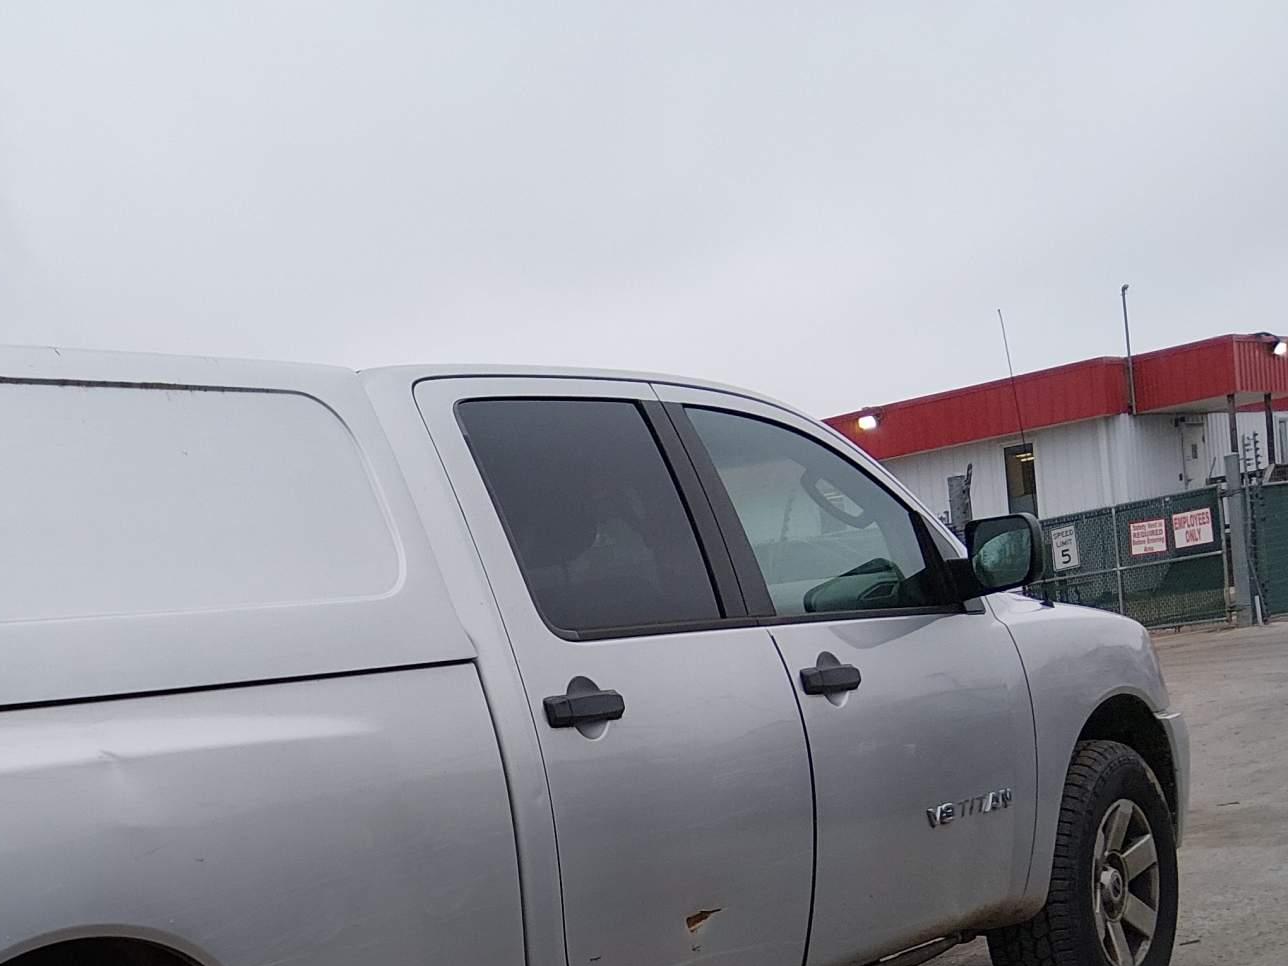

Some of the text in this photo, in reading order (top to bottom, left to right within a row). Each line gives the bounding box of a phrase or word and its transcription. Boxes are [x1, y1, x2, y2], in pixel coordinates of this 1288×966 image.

[1173, 511, 1210, 530] EMPLOYEES
[1052, 530, 1073, 540] SPEED
[1185, 528, 1201, 543] ONLY
[1056, 539, 1073, 548] LIMIT
[1061, 548, 1072, 564] 5
[959, 788, 1012, 817] TITAN
